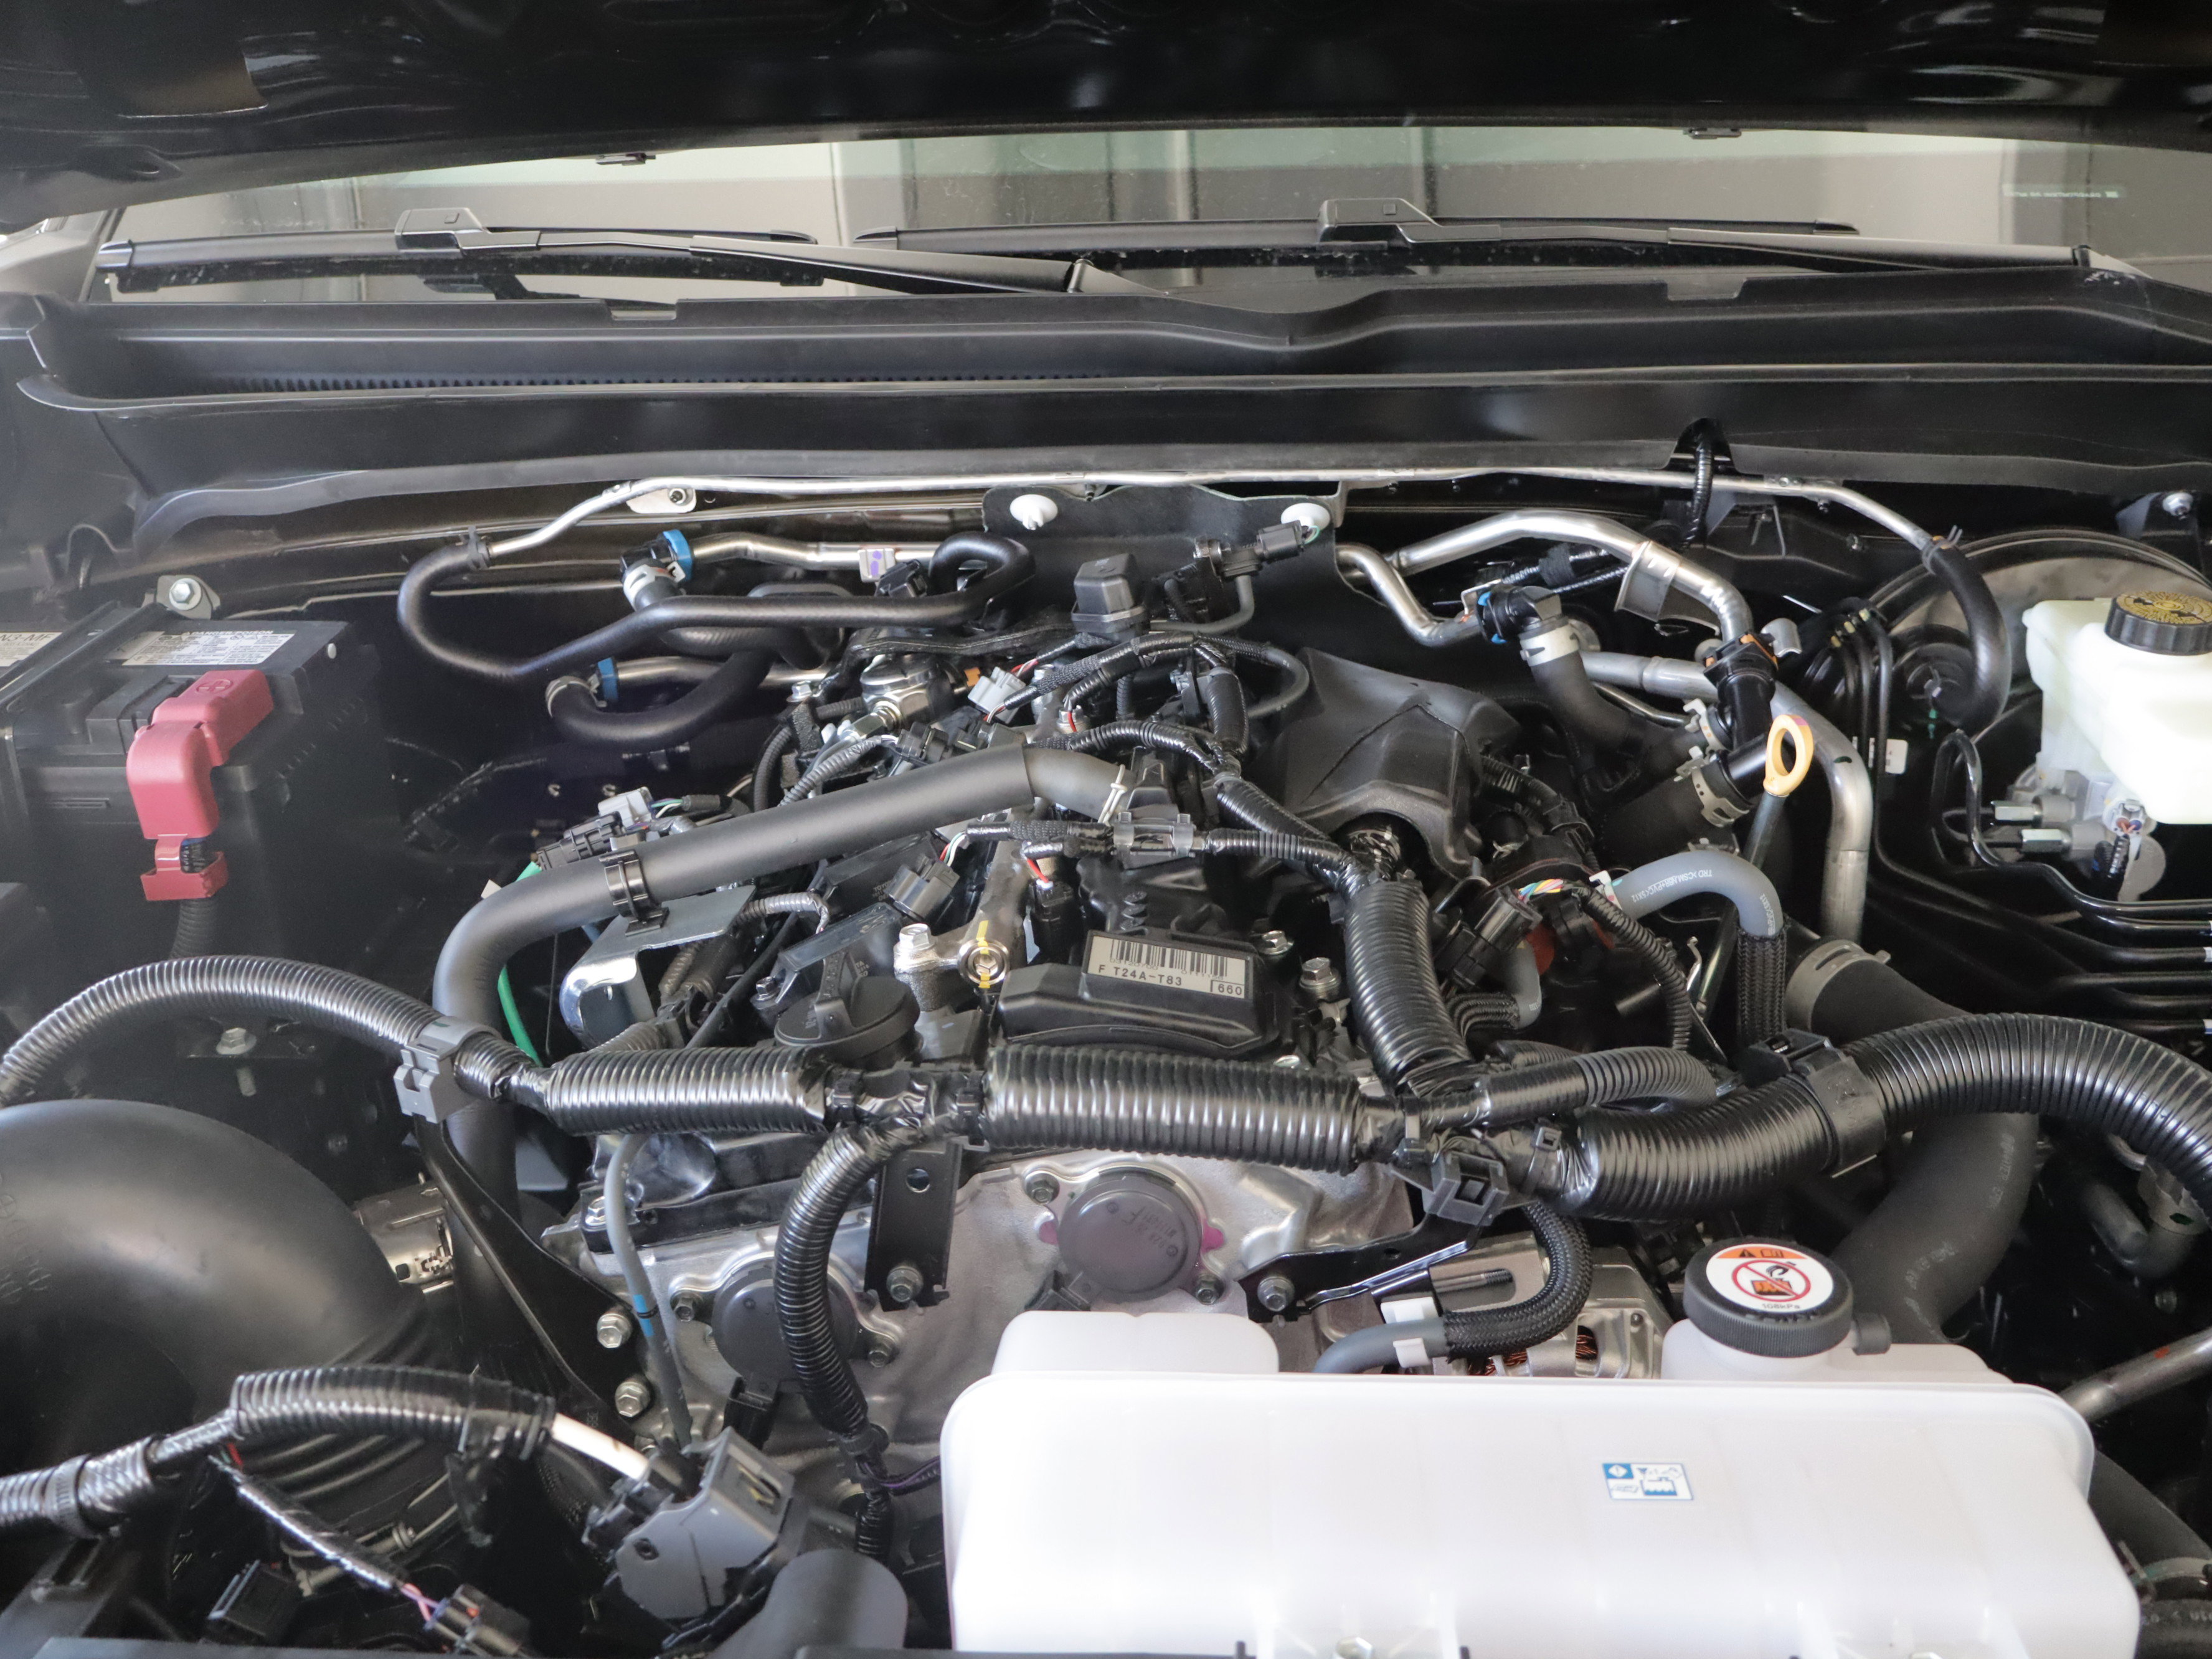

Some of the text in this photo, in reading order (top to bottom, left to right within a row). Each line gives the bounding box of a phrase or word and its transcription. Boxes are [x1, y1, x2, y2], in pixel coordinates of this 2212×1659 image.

[1098, 964, 1242, 996] F T24A-T83 660
